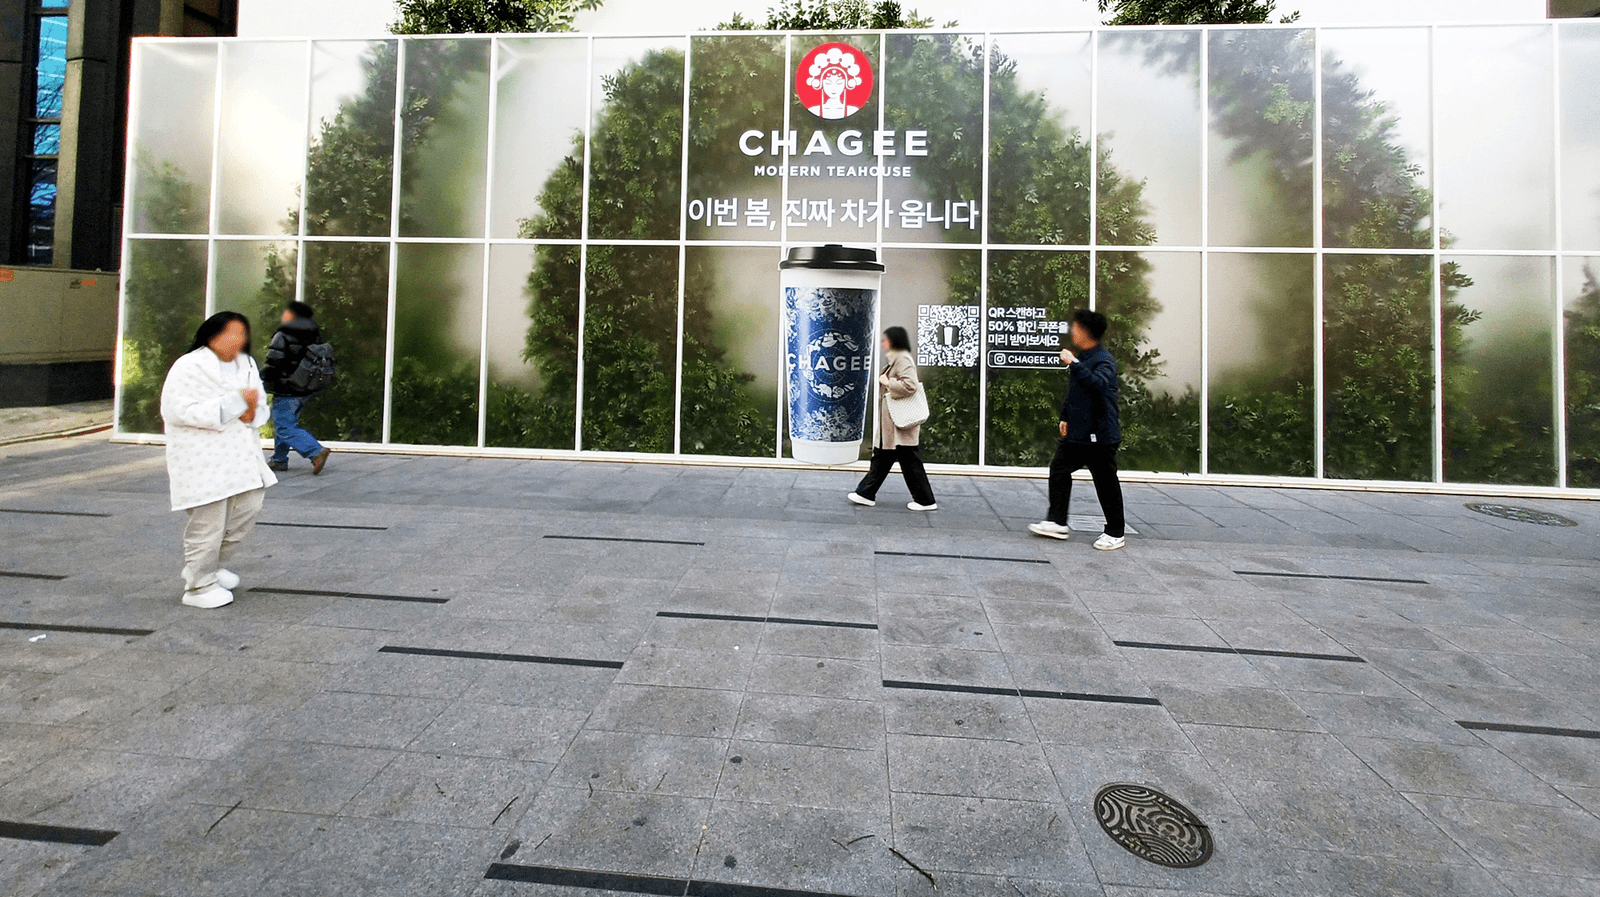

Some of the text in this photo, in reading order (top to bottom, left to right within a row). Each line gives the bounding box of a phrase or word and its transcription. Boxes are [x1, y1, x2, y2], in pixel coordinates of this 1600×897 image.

[738, 129, 928, 156] CHAGEE
[754, 165, 911, 177] MODERN TEAHOUSE
[688, 197, 979, 231] 이번 봄, 진짜 차가 옵니다
[988, 321, 1014, 332] 50%
[987, 334, 1060, 347] 미리 받아보세요
[787, 353, 871, 371] CHAGEE
[1008, 355, 1060, 365] CHAGEE.KR
